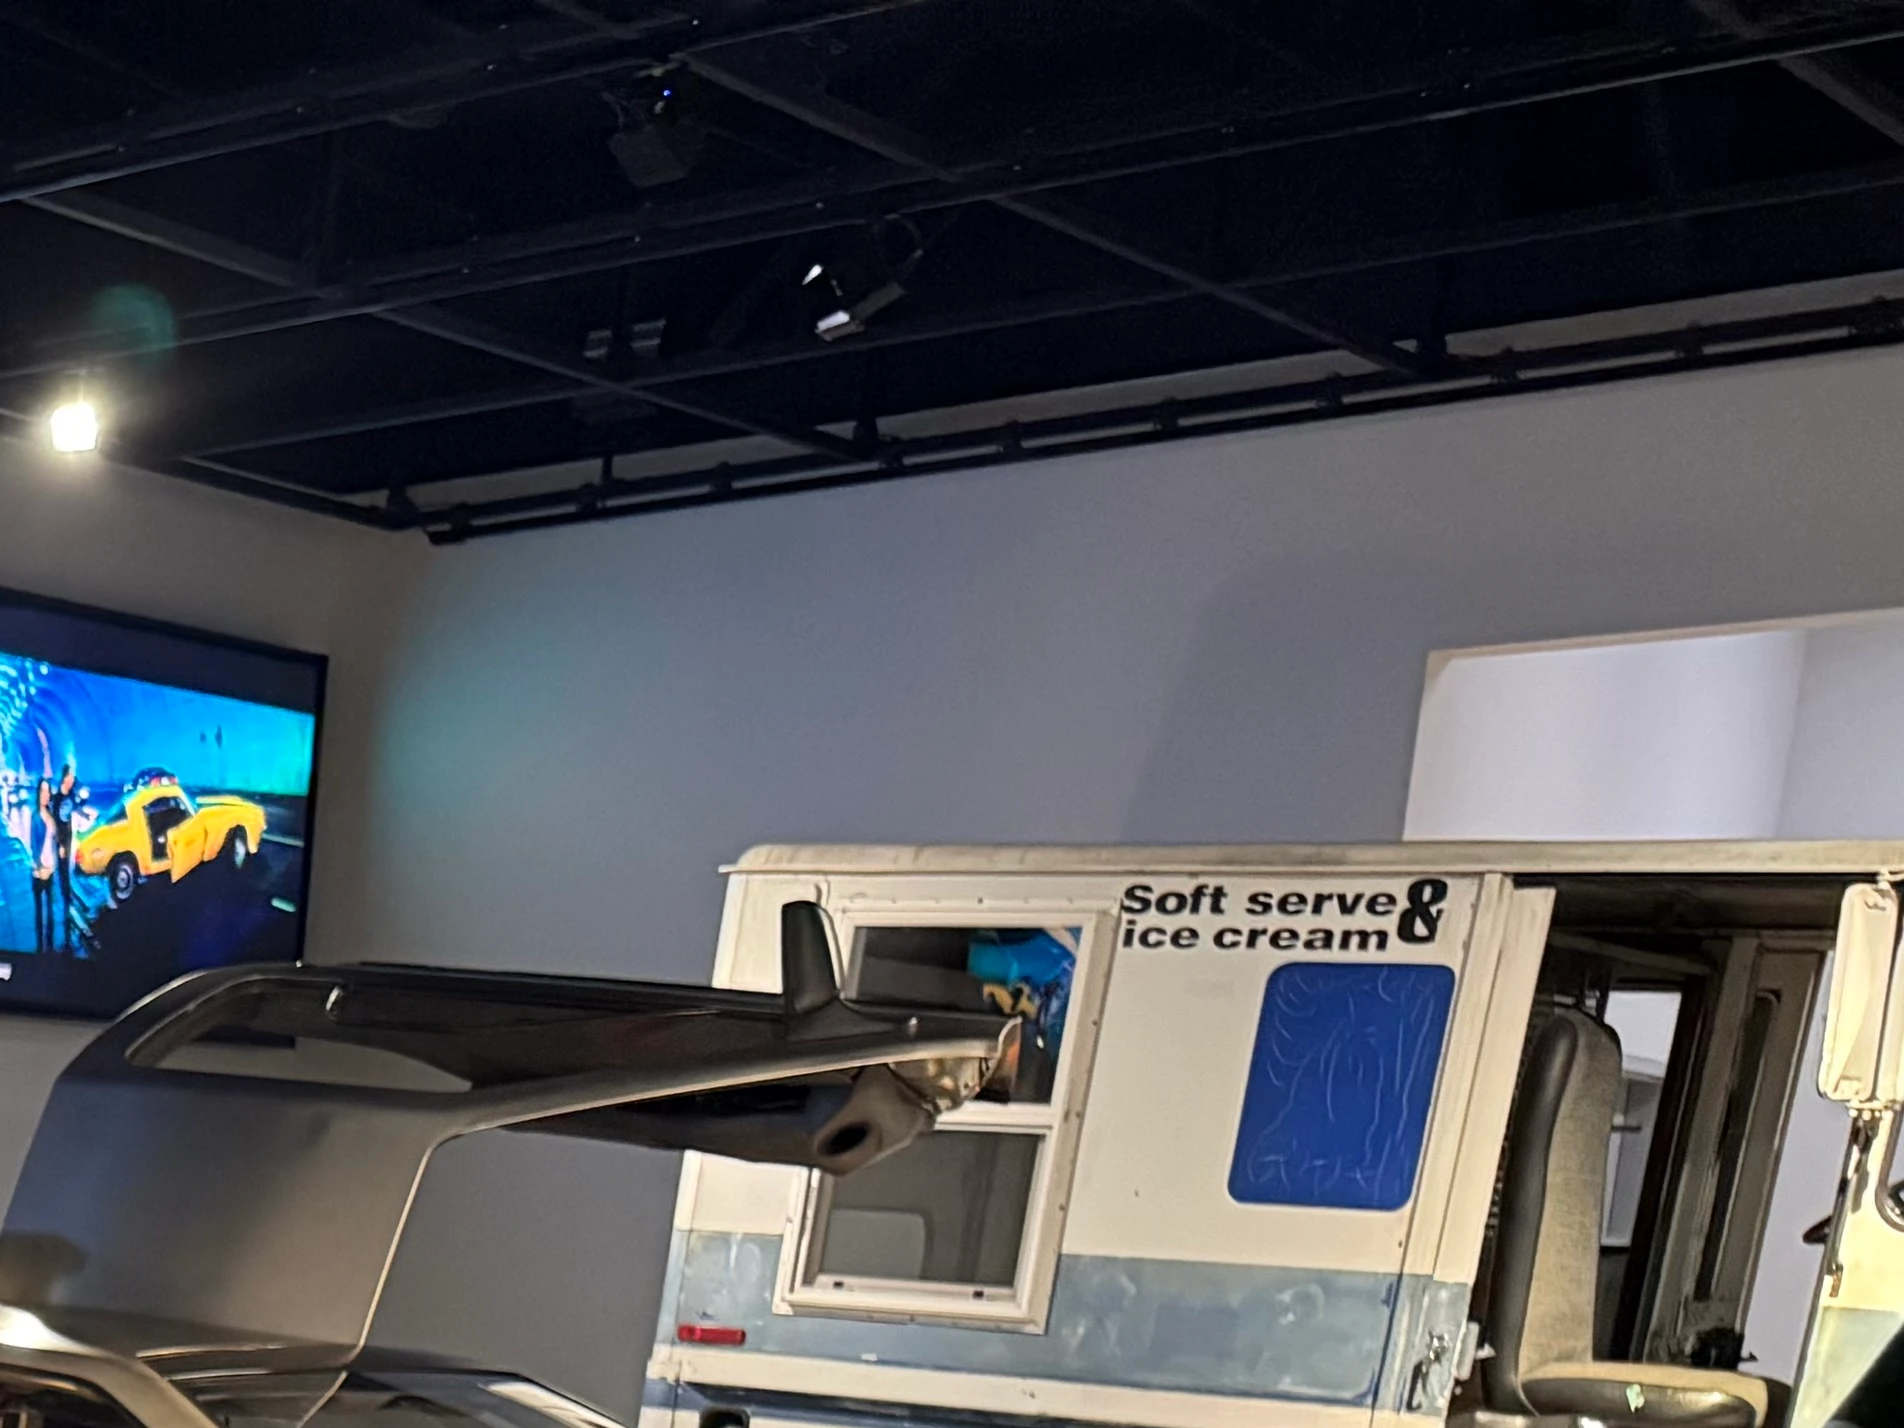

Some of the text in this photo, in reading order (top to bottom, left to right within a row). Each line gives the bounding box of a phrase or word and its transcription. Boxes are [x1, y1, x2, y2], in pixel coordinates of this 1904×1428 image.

[1121, 884, 1397, 917] Soft serve
[1396, 878, 1448, 945] &
[1122, 919, 1389, 952] ice cream
